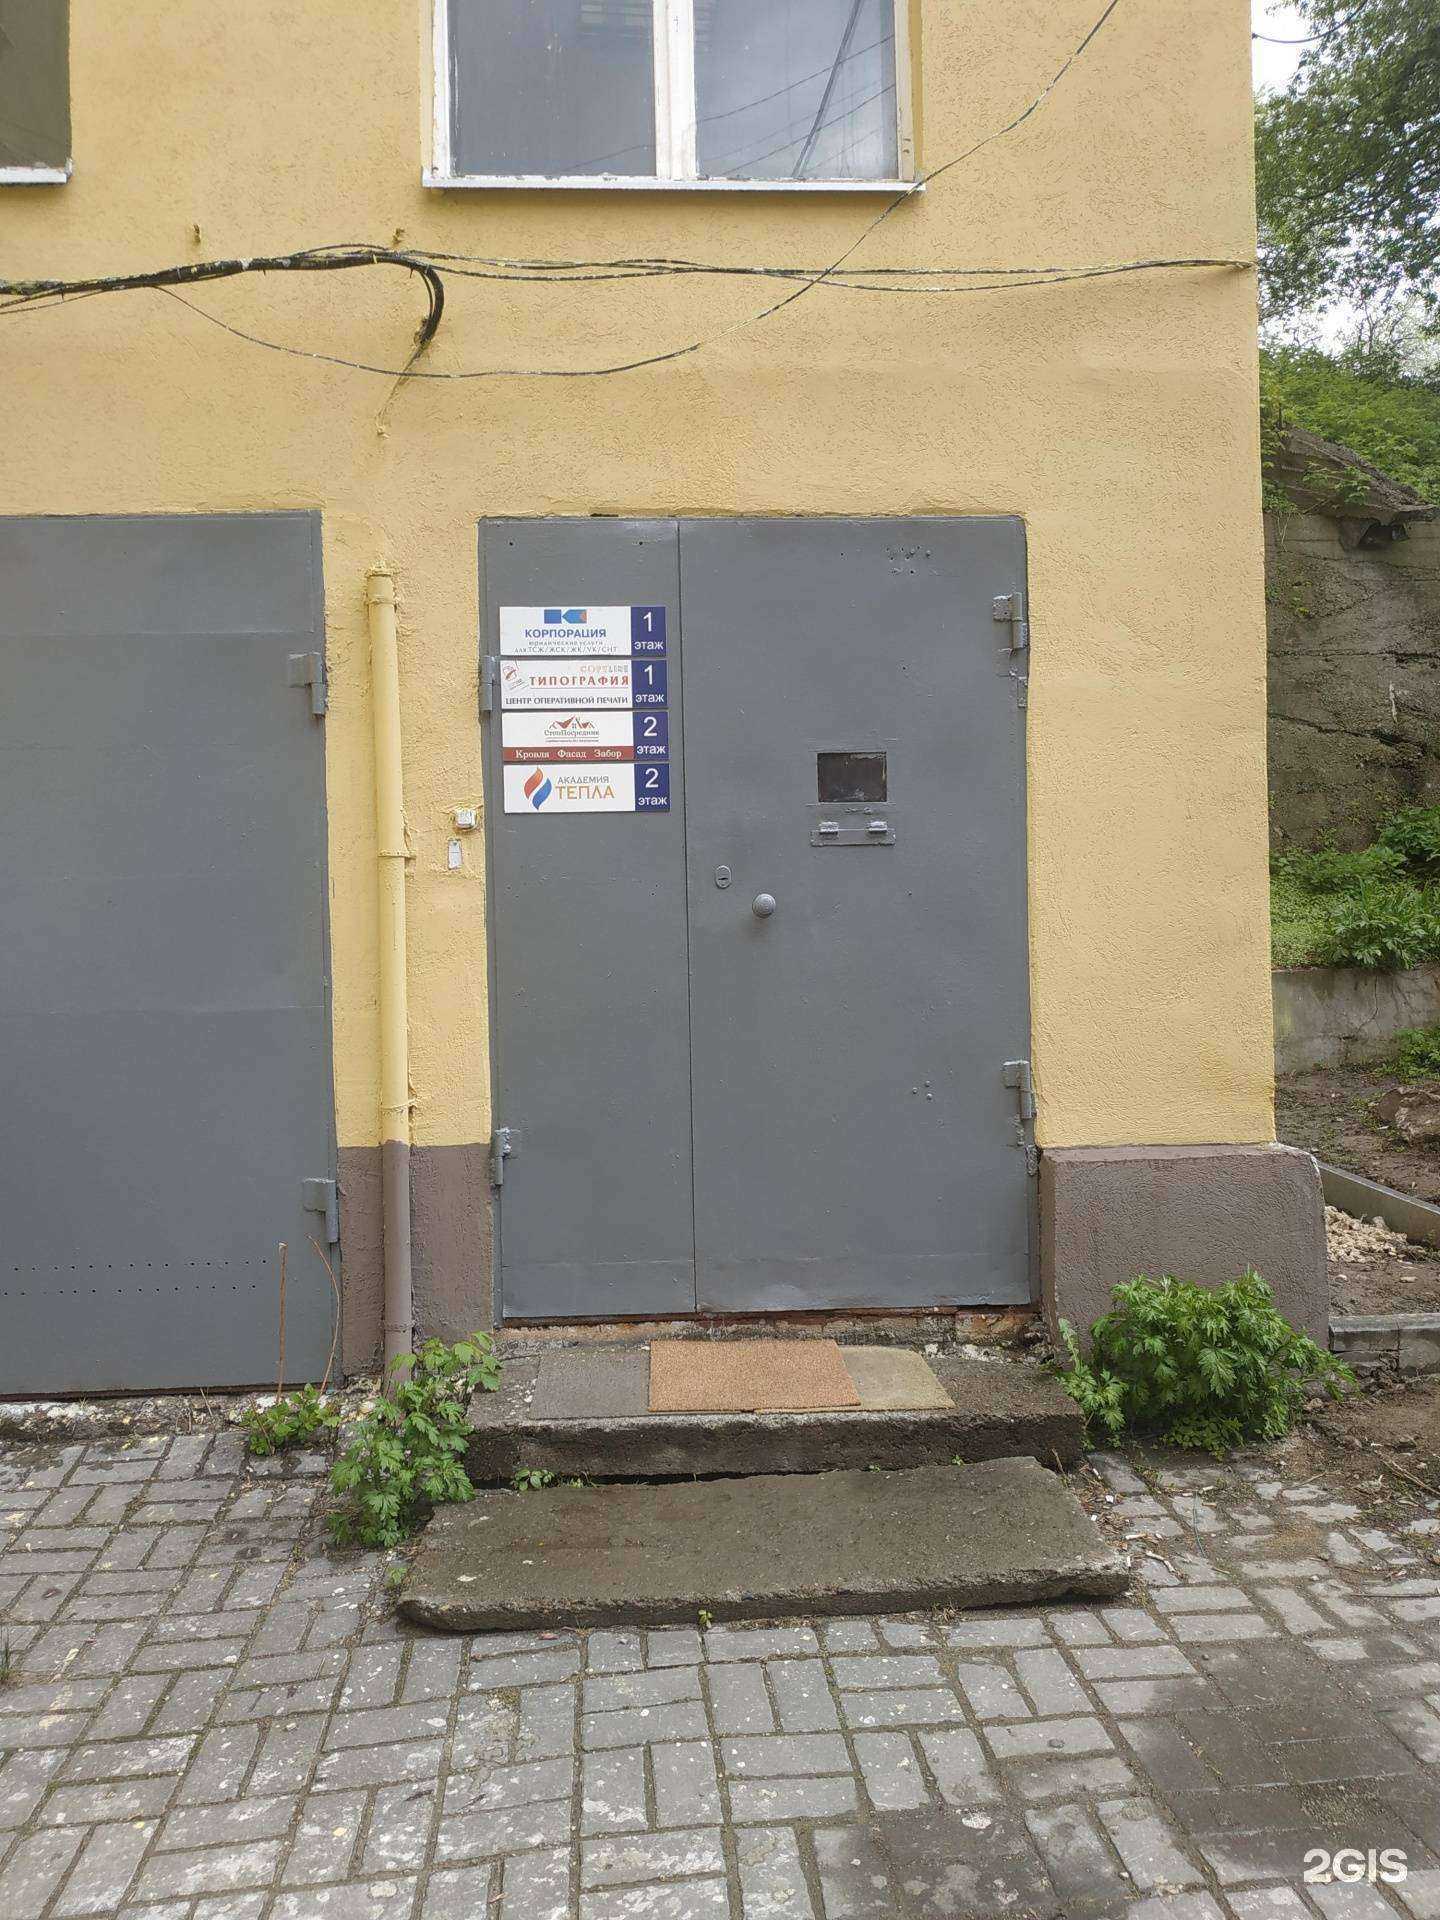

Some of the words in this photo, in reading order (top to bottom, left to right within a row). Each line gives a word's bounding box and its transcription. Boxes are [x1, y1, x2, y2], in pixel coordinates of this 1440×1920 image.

[643, 612, 653, 632] 1
[525, 629, 606, 638] КОРПОРАЦИЯ
[634, 641, 664, 650] этаж
[644, 665, 653, 685] 1
[529, 676, 629, 686] ТИПОГРАФИЯ
[505, 697, 532, 705] ЦЕНТР
[534, 696, 595, 705] ОПЕРАТИВНОЙ
[635, 694, 665, 703] этаж
[643, 716, 658, 737] 2
[515, 750, 549, 759] Кровля
[557, 749, 587, 759] Фасад
[594, 749, 622, 759] Забор
[637, 745, 666, 754] этаж
[557, 776, 609, 784] АКАДЕМИЯ
[645, 768, 659, 788] 2
[555, 785, 615, 800] ТЕПЛА
[638, 796, 667, 805] этаж
